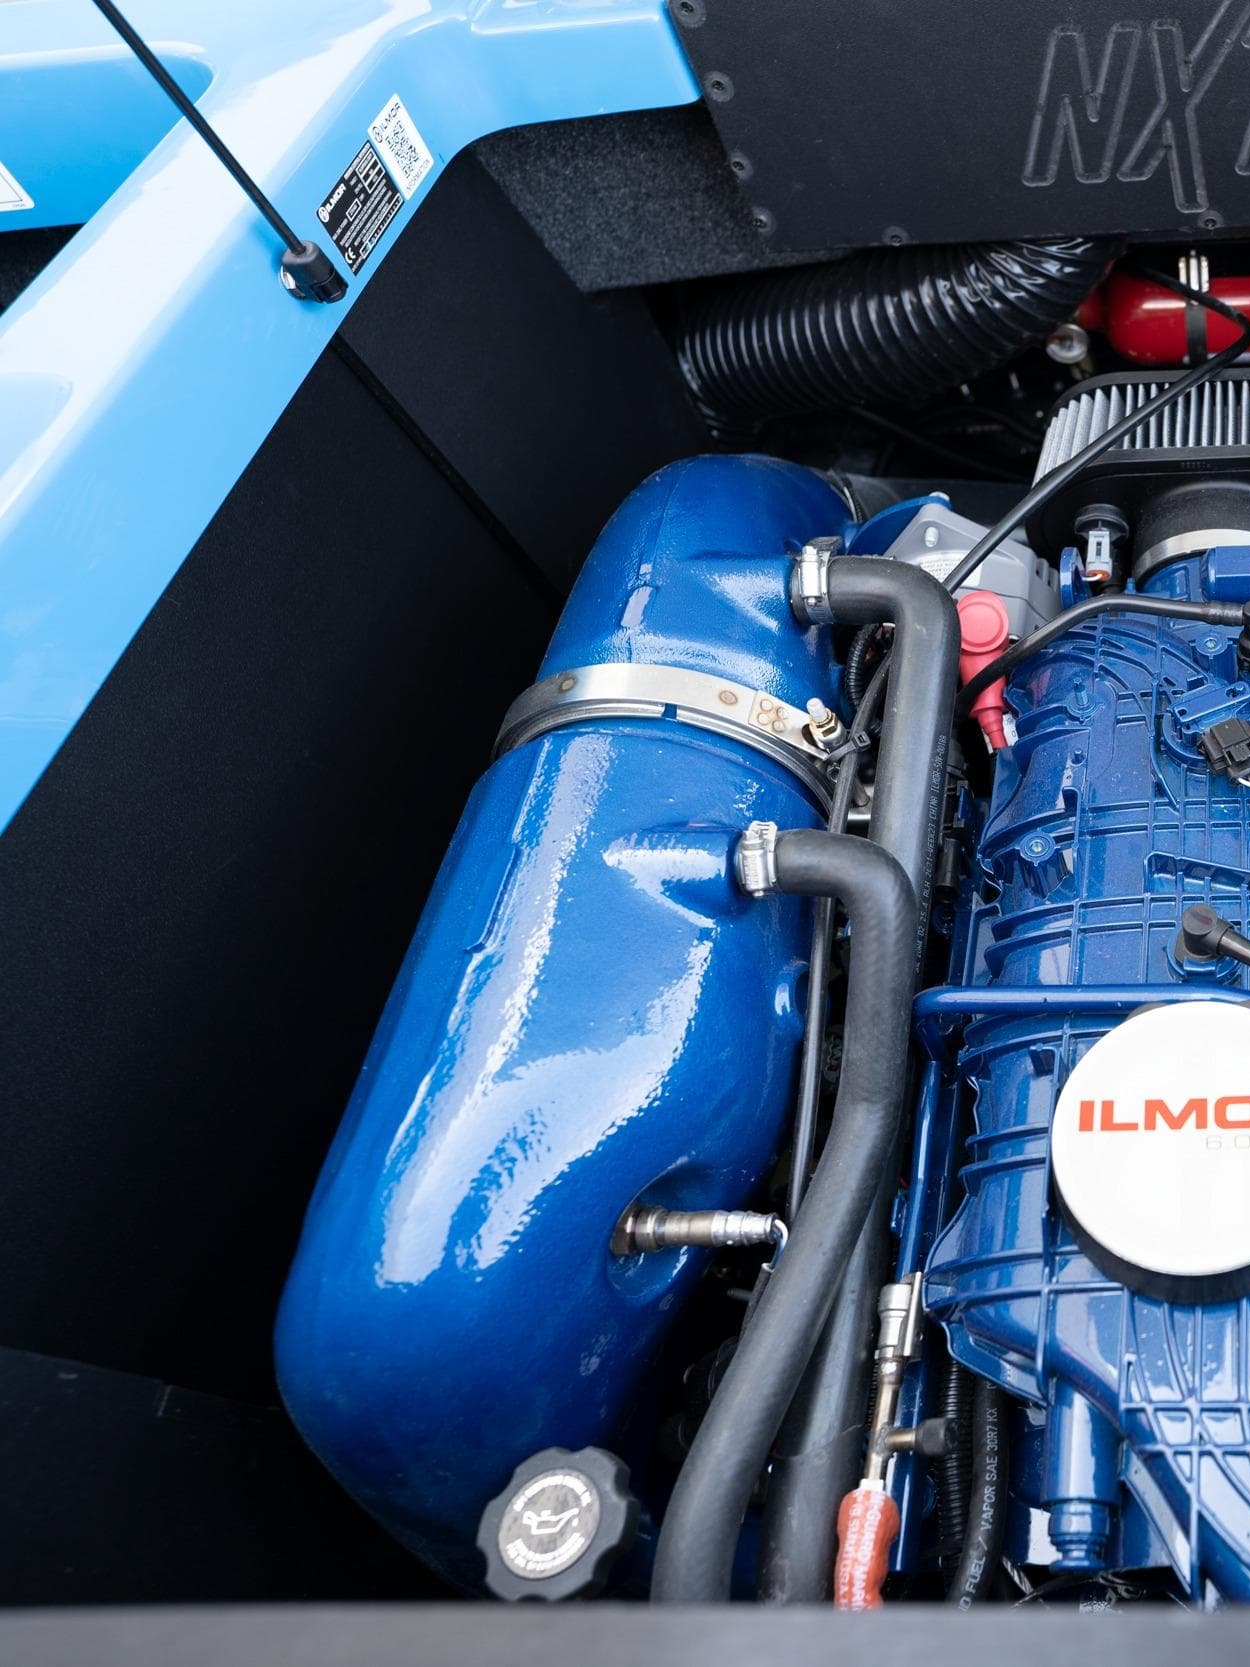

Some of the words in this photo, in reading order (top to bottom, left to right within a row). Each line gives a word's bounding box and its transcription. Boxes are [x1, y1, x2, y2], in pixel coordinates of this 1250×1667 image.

[379, 102, 401, 133] ILMOR
[326, 183, 347, 213] ILMOR
[986, 1407, 998, 1422] KX
[987, 1424, 999, 1452] 30R7
[985, 1456, 999, 1481] SAE
[980, 1484, 997, 1531] VAPOR
[965, 1556, 986, 1594] FUEL
